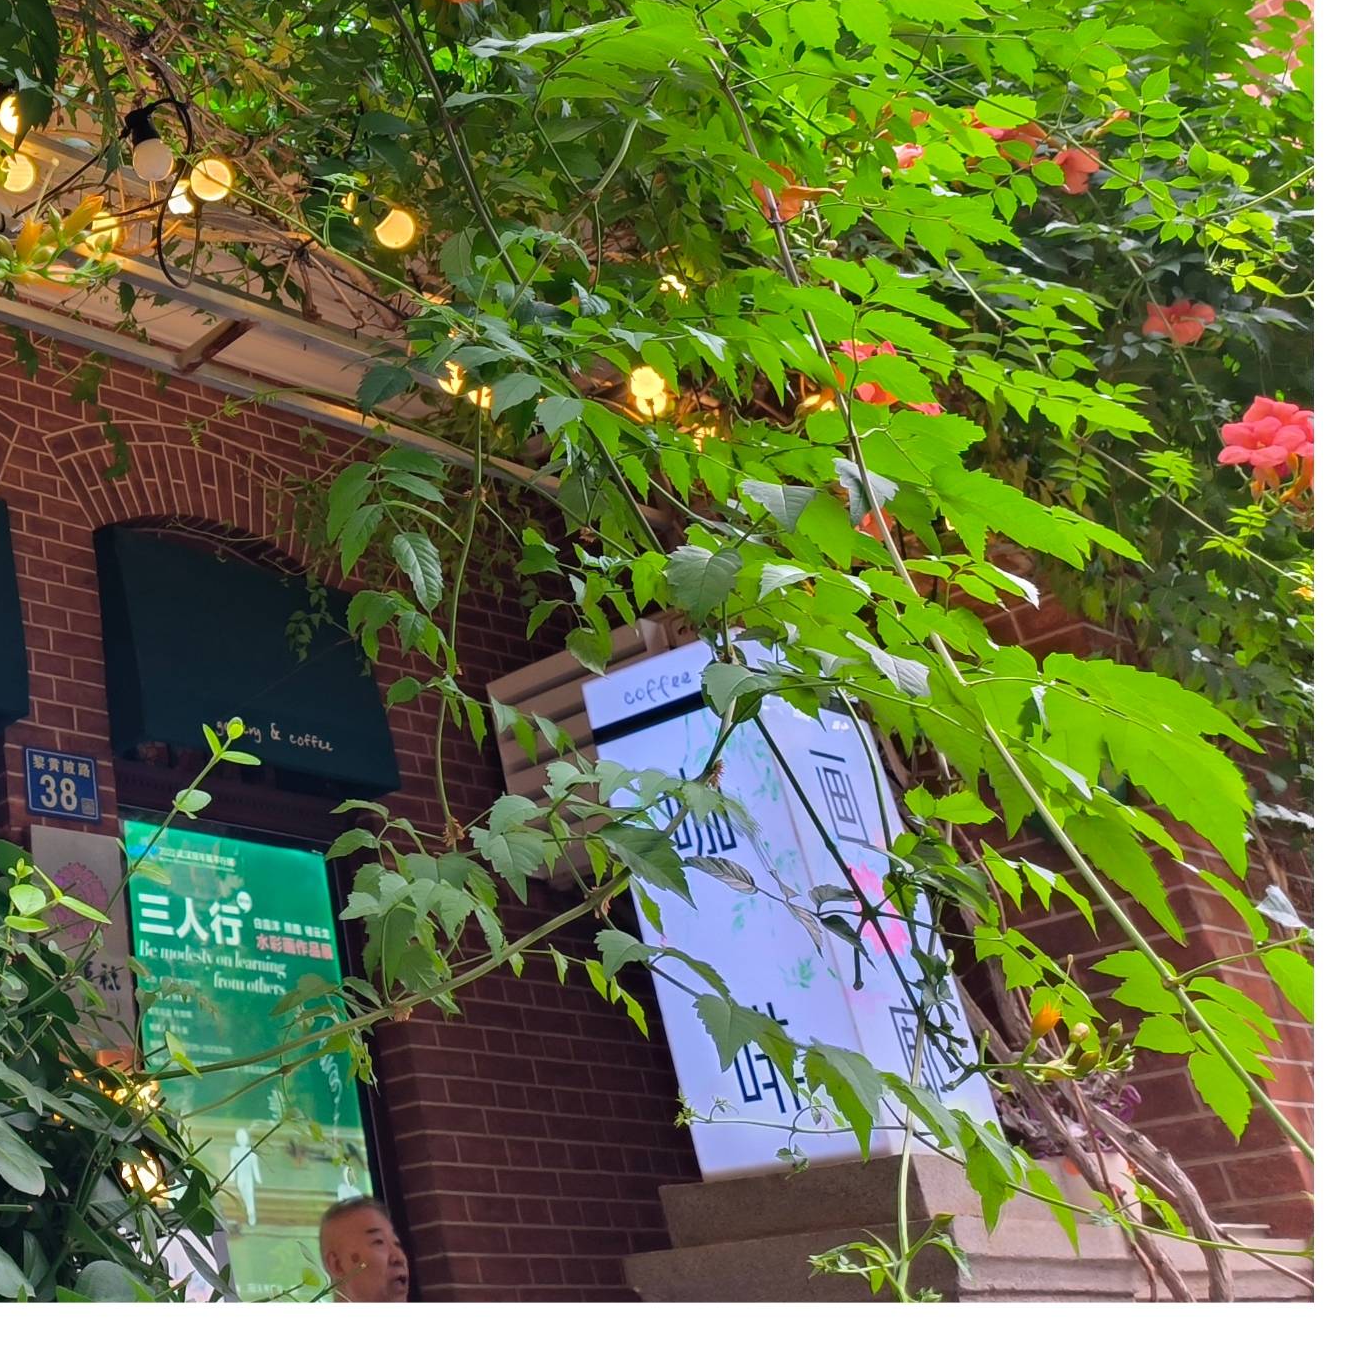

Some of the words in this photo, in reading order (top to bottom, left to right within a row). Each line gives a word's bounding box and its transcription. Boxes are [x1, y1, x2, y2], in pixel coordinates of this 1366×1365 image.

[622, 671, 692, 706] coffee
[270, 722, 282, 741] &
[289, 733, 334, 752] coffee
[39, 774, 78, 812] 38
[137, 892, 244, 947] 三人行
[139, 938, 156, 959] Be
[215, 952, 234, 968] on
[235, 950, 287, 980] learning
[213, 970, 245, 992] from
[246, 975, 287, 997] others
